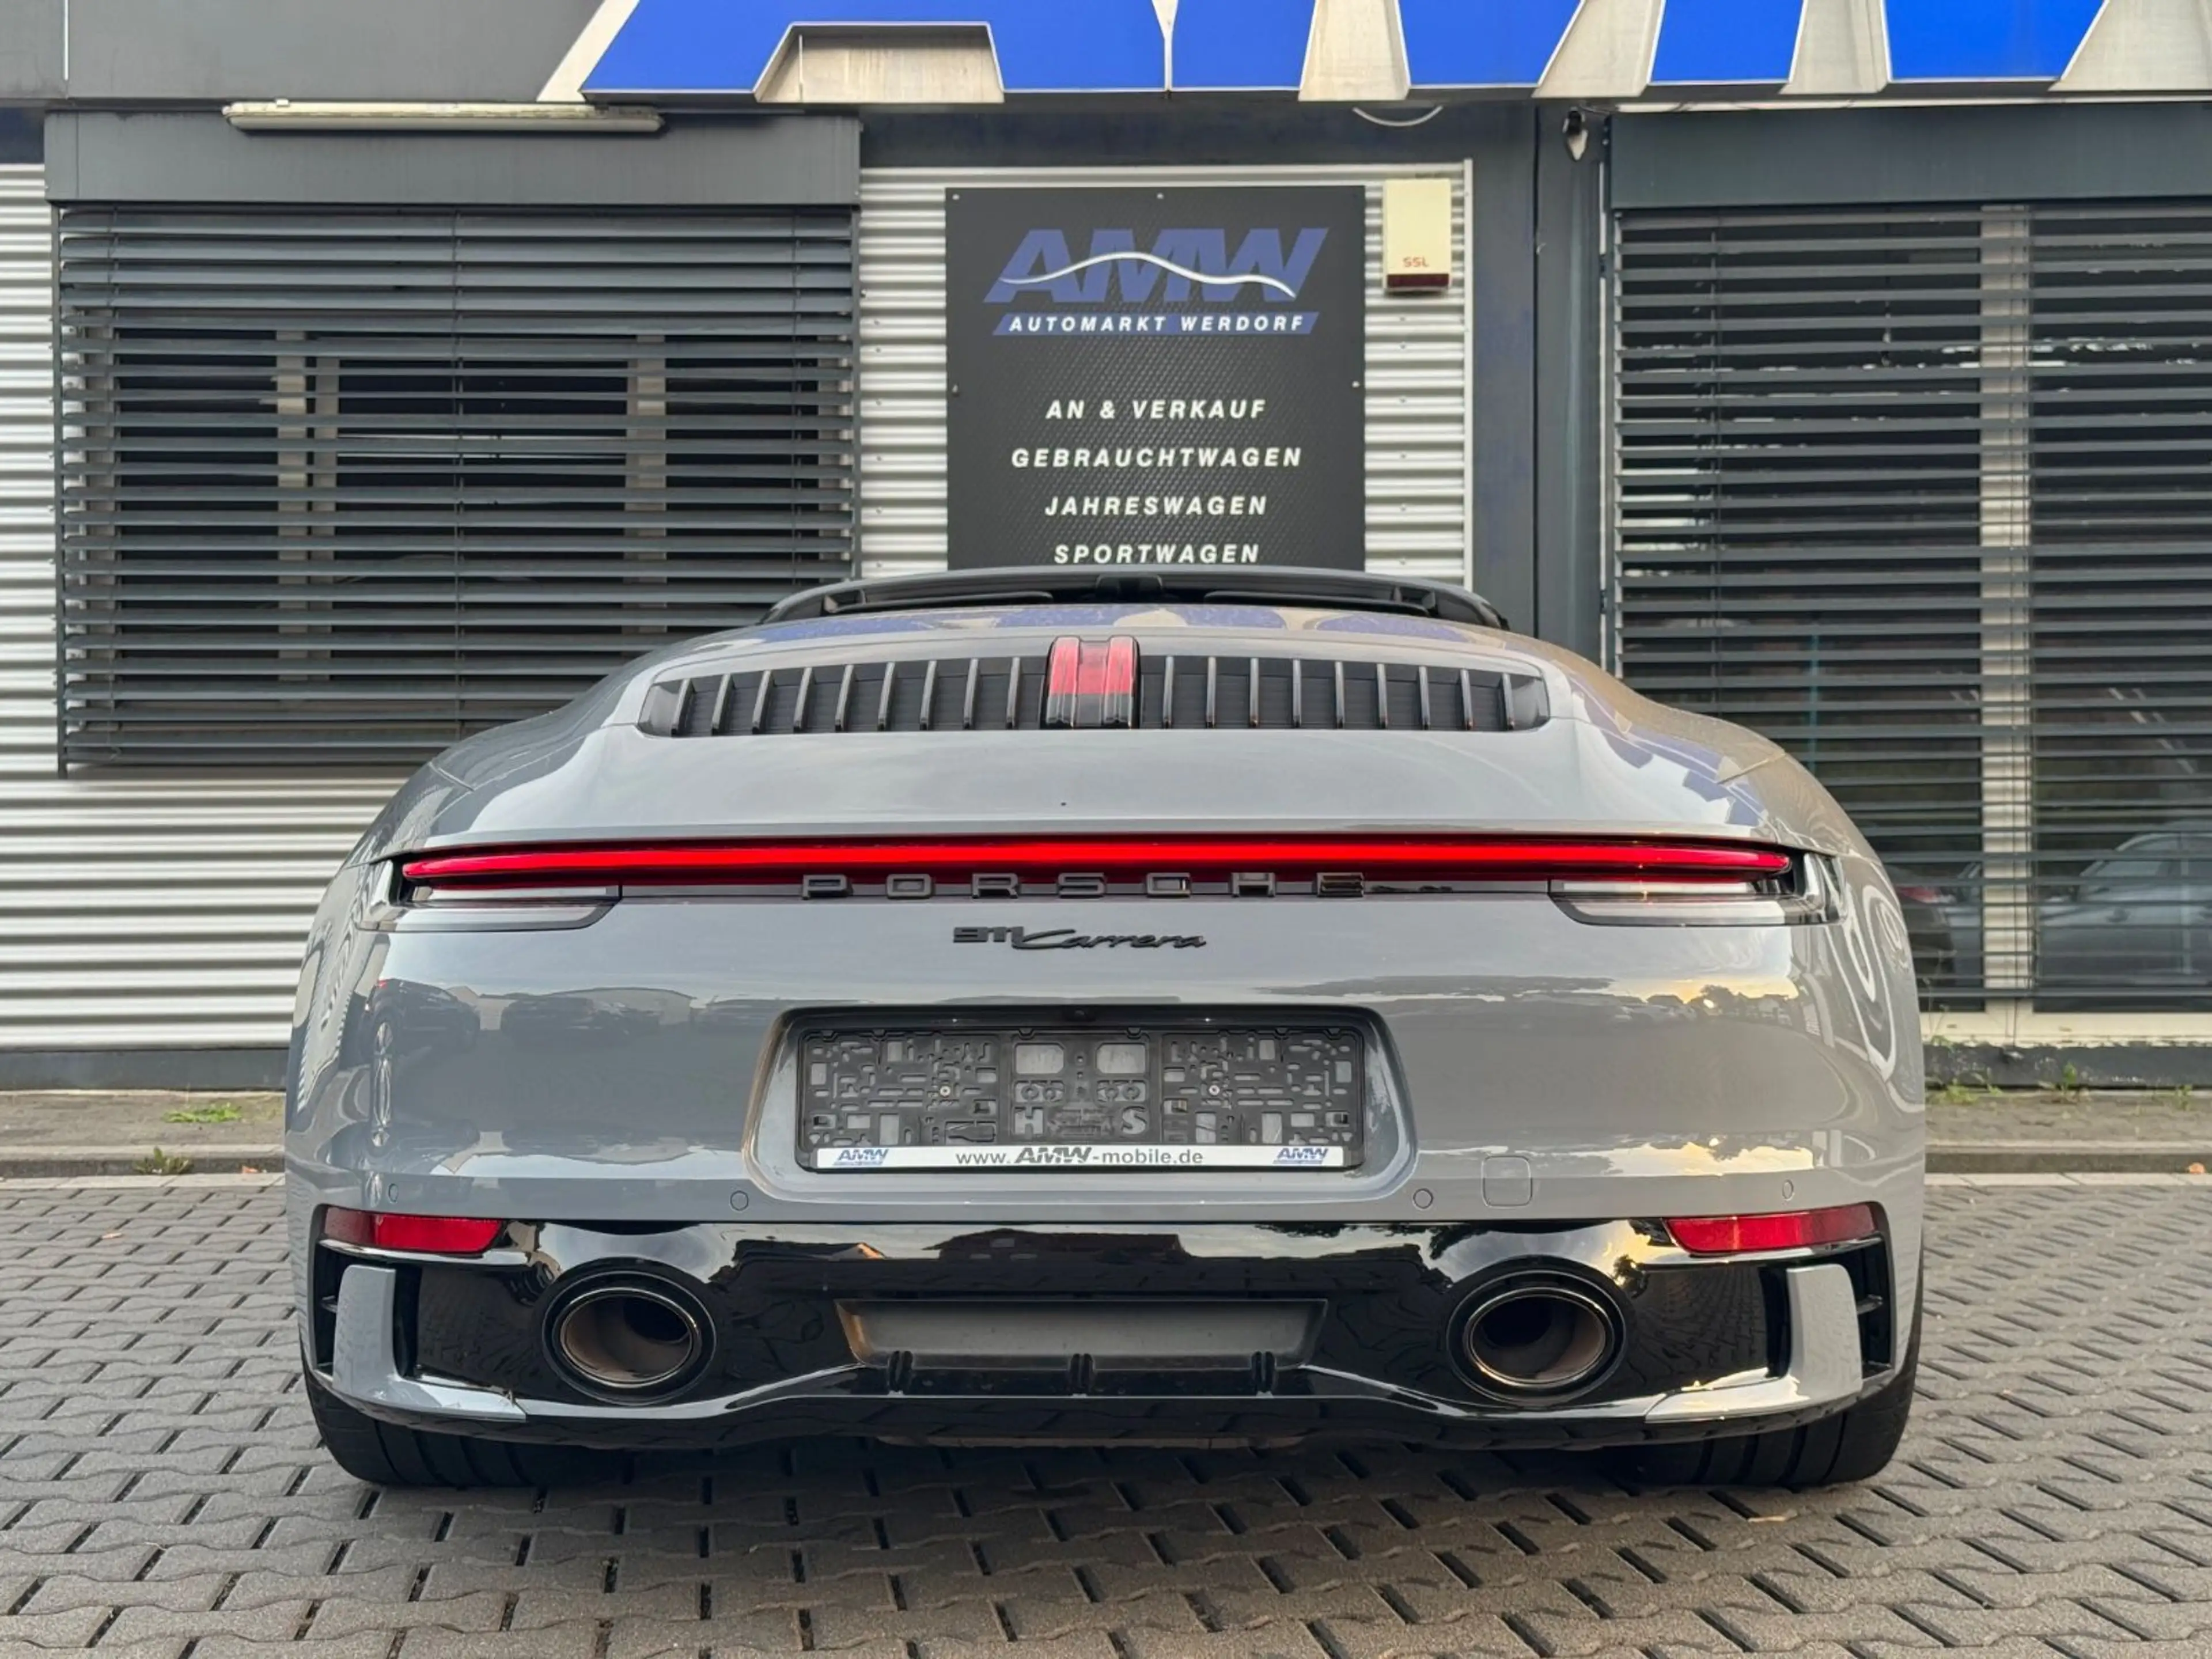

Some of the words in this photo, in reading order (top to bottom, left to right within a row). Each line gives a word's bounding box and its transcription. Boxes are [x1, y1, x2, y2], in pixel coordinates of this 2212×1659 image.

[983, 228, 1329, 302] AMW
[1009, 315, 1166, 332] AUTOMARKT
[1181, 315, 1305, 331] WERDORF
[1045, 400, 1085, 419] AN
[1100, 400, 1115, 419] &
[1132, 399, 1267, 419] VERKAUF
[1011, 447, 1301, 468] GEBRAUCHTWAGEN
[1044, 496, 1267, 516] JAHRESWAGEN
[1054, 544, 1260, 564] SPORTWAGEN
[801, 872, 1365, 900] PORSCHE
[953, 926, 1024, 943] 911
[1012, 929, 1207, 950] Carrera
[838, 1148, 889, 1161] AMW
[955, 1147, 1204, 1164] www.AMW-mobile.de
[1277, 1147, 1328, 1160] AMW
